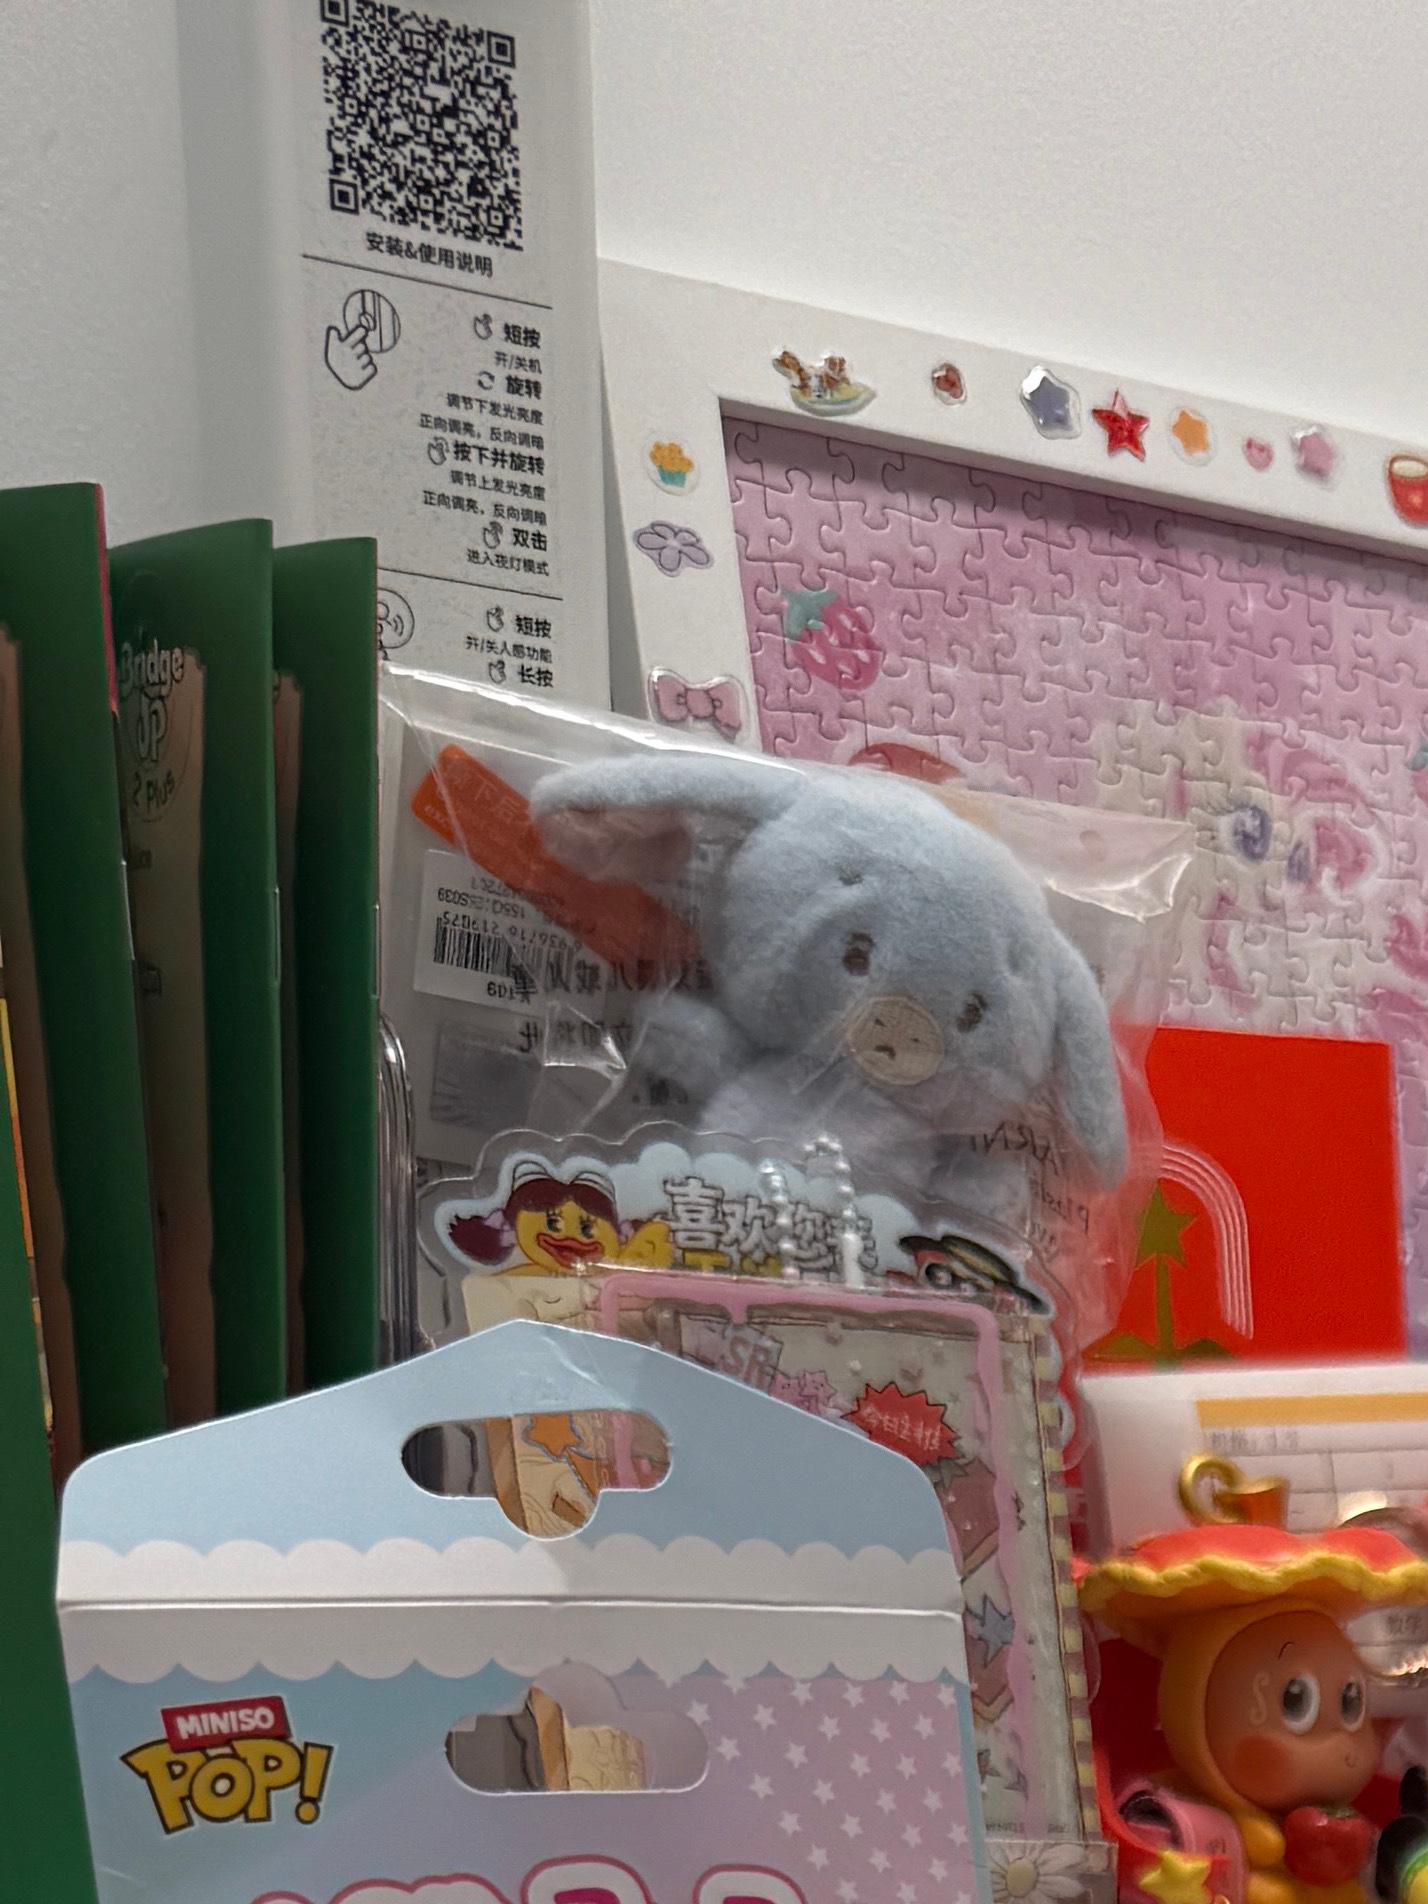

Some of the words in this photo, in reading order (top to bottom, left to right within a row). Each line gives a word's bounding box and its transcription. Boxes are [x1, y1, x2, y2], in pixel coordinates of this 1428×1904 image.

[366, 232, 493, 277] 安装&使用说明
[503, 323, 541, 349] 短按
[505, 375, 542, 400] 旋转
[453, 440, 545, 476] 按下并旋转
[512, 528, 548, 552] 双击
[515, 615, 552, 639] 短按
[518, 665, 553, 688] 长按
[176, 1706, 275, 1739] MINISO
